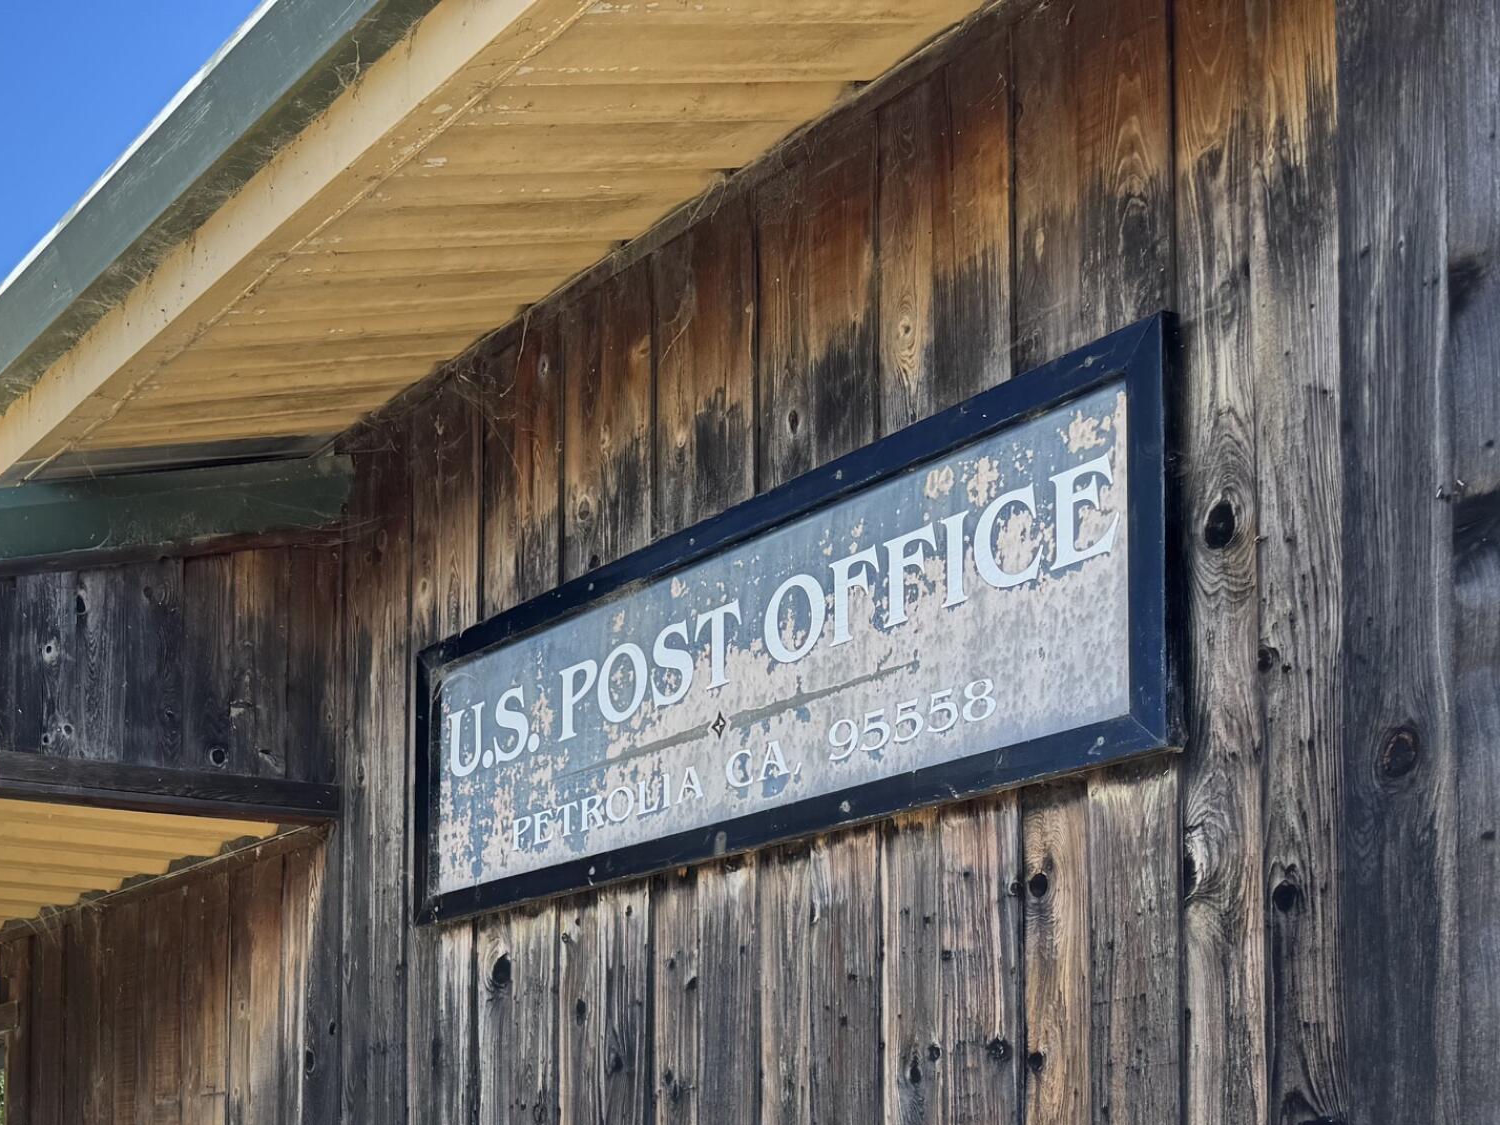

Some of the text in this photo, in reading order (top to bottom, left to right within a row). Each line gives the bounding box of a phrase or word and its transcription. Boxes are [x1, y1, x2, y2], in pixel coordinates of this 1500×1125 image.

[449, 453, 1121, 778] U.S. POST OFFICE
[512, 766, 704, 851] PETROLIA
[828, 678, 997, 762] 95558
